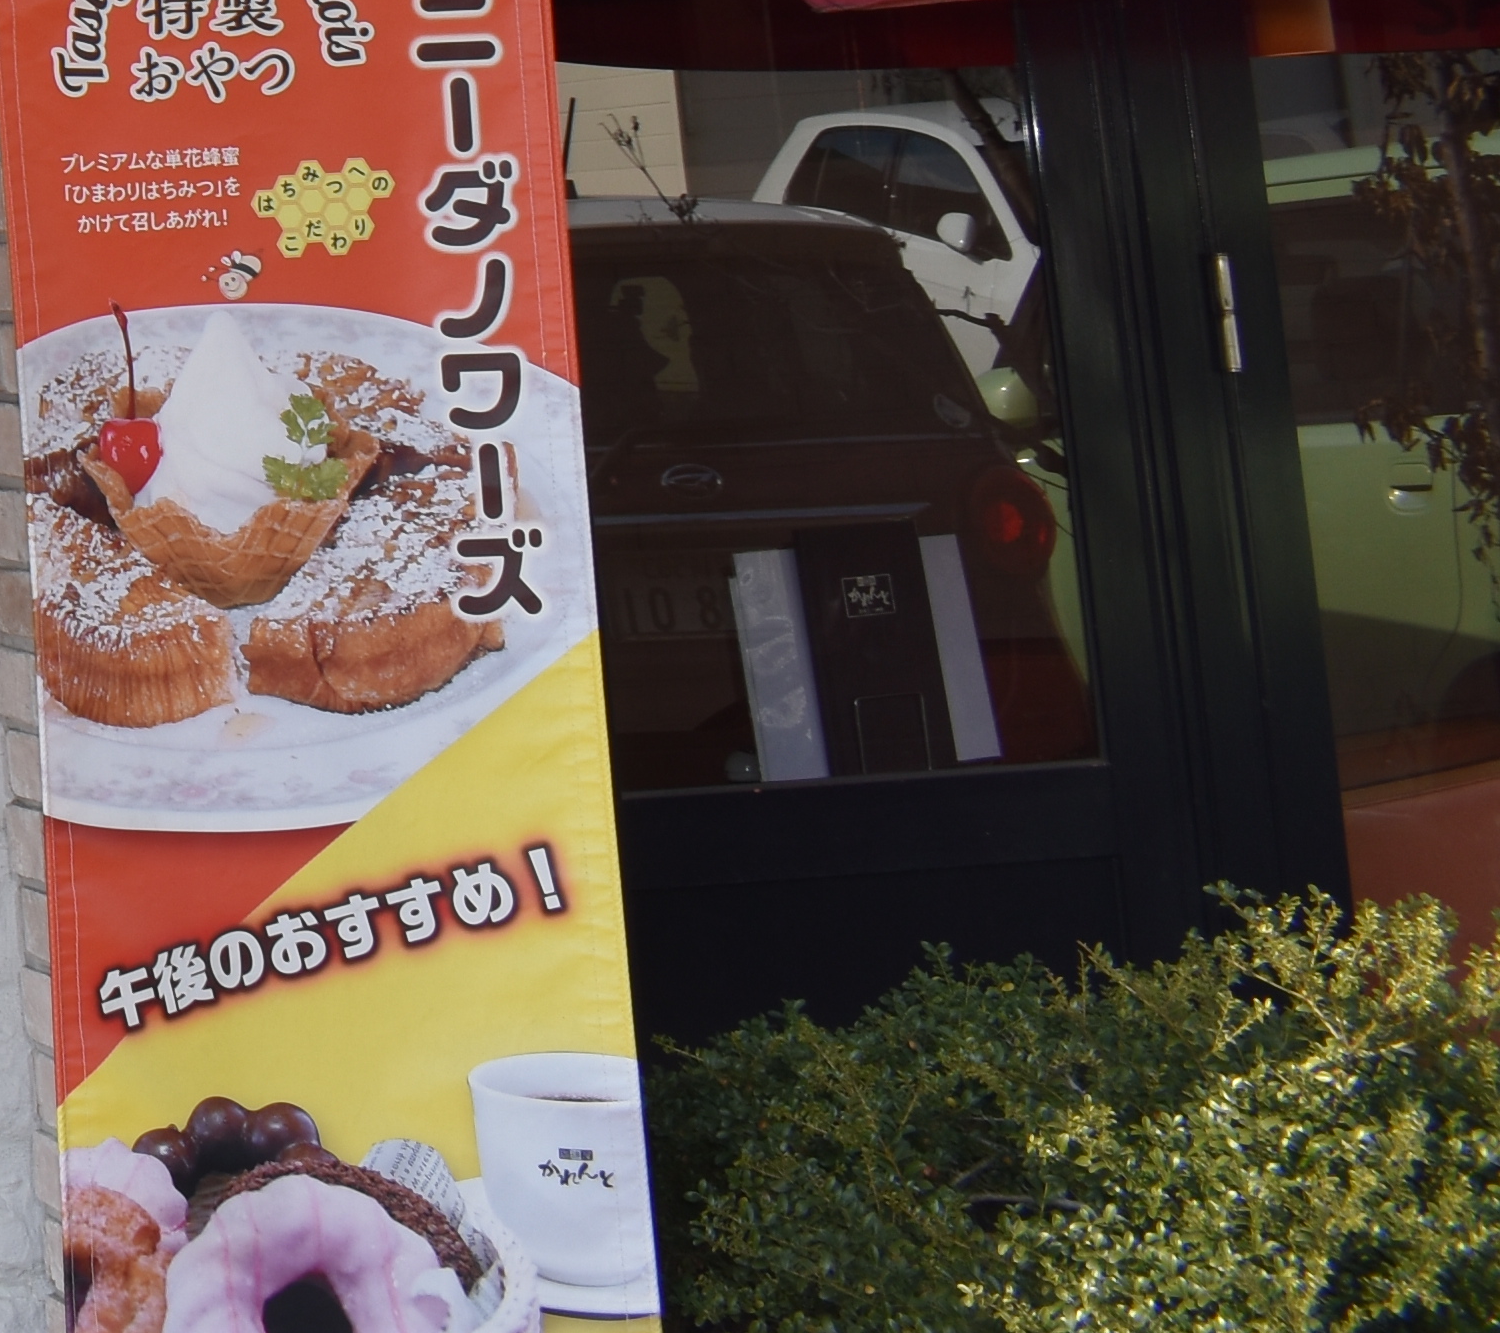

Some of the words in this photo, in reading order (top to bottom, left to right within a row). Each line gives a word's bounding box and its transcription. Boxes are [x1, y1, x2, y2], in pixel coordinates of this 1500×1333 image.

[131, 42, 295, 103] おやつ
[60, 146, 241, 174] プレミアムな単花蜂蜜
[63, 176, 241, 203] 「ひまわりはちみつ」を
[98, 847, 567, 1027] 午後のおすすめ！
